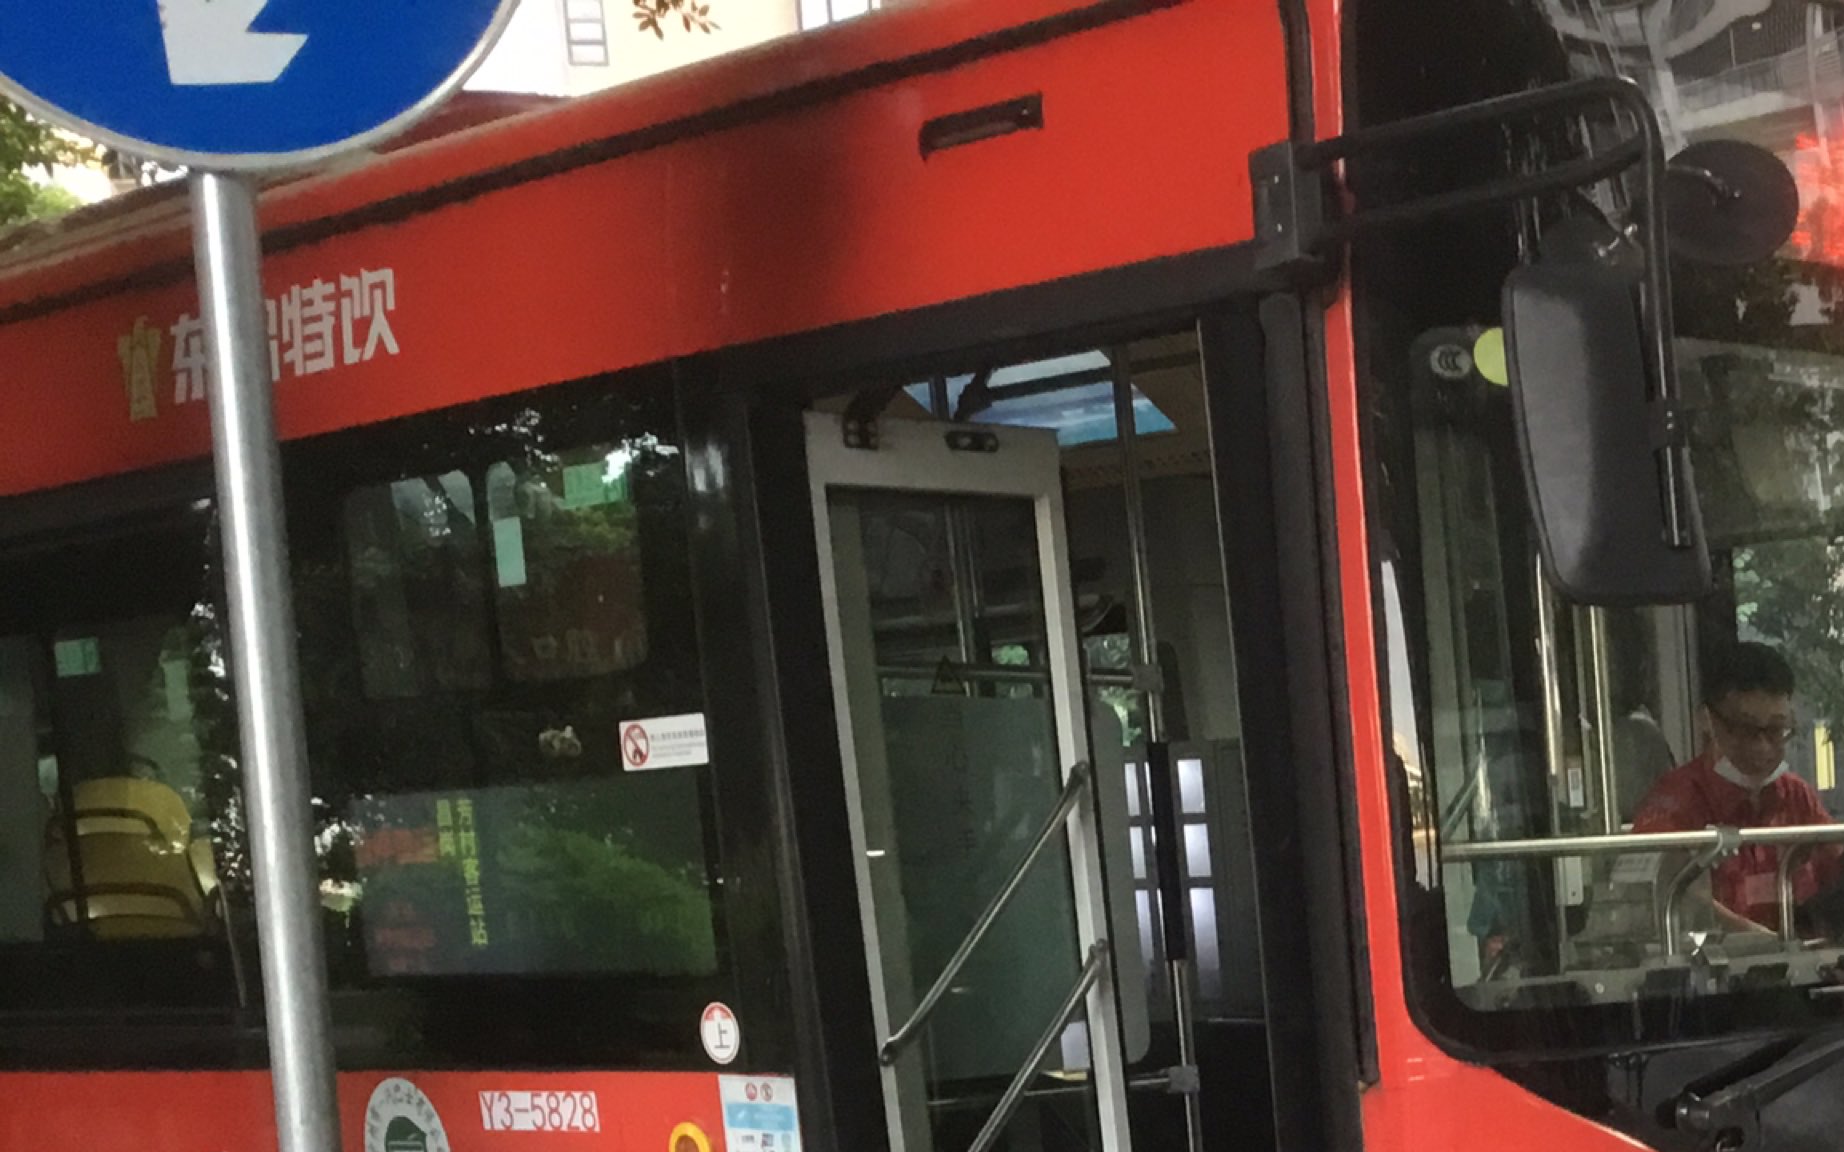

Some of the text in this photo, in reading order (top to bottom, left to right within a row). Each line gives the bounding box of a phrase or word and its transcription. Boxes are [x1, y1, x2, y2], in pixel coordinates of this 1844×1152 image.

[169, 267, 400, 405] 东特饮
[480, 1091, 597, 1130] Y3-5828
